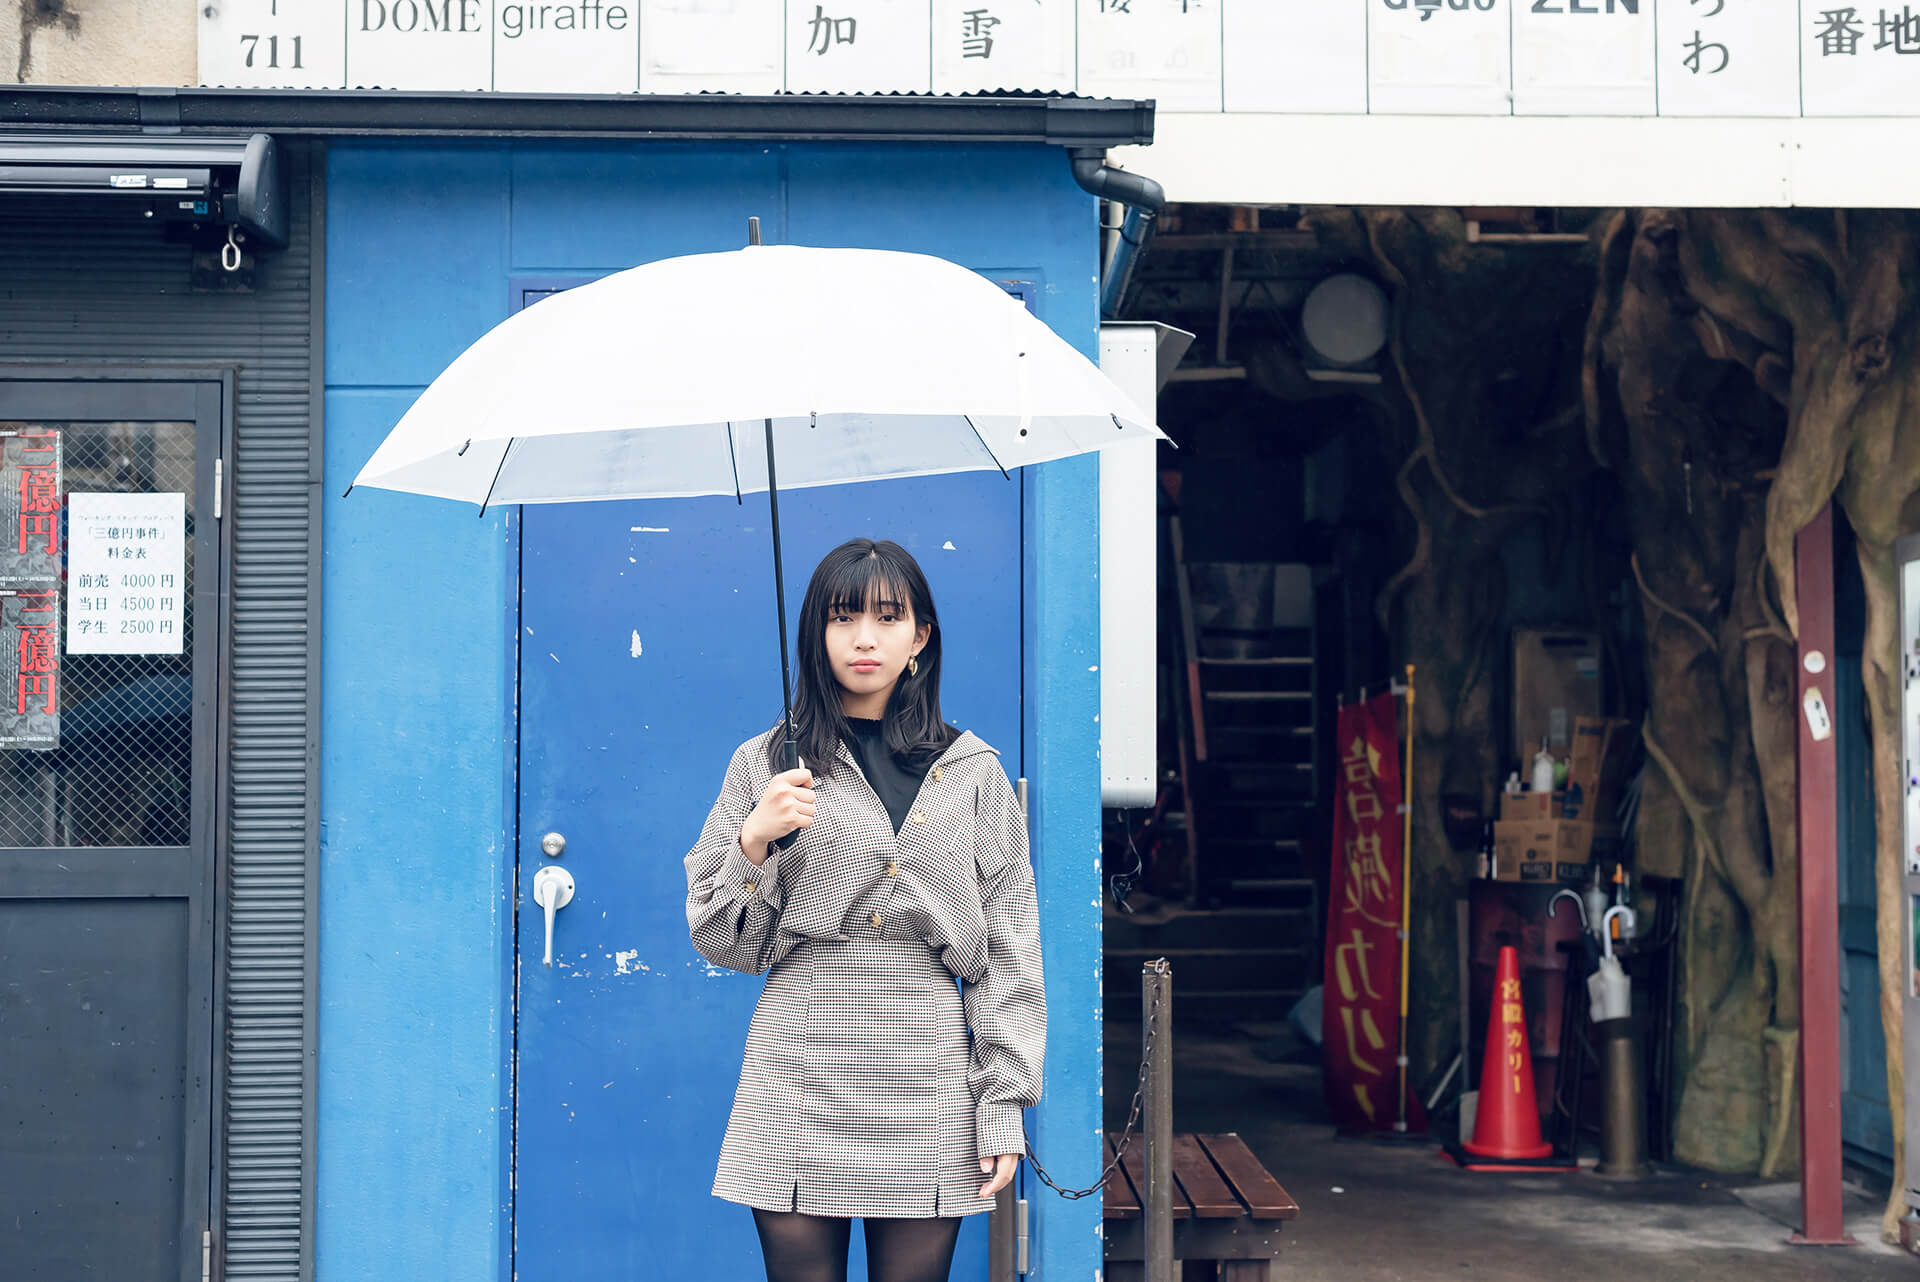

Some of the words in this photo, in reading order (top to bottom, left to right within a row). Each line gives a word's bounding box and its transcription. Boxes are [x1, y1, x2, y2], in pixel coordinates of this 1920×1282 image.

[360, 0, 482, 32] DOME
[503, 0, 627, 38] giraffe
[807, 4, 857, 56] 加
[961, 8, 1002, 59] 雪
[240, 35, 304, 69] 711
[16, 429, 60, 555] 三億円
[108, 546, 147, 559] 料金表
[79, 574, 109, 588] 前売
[80, 597, 107, 611] 当日
[78, 619, 108, 634] 学生
[15, 588, 58, 715] 三億円
